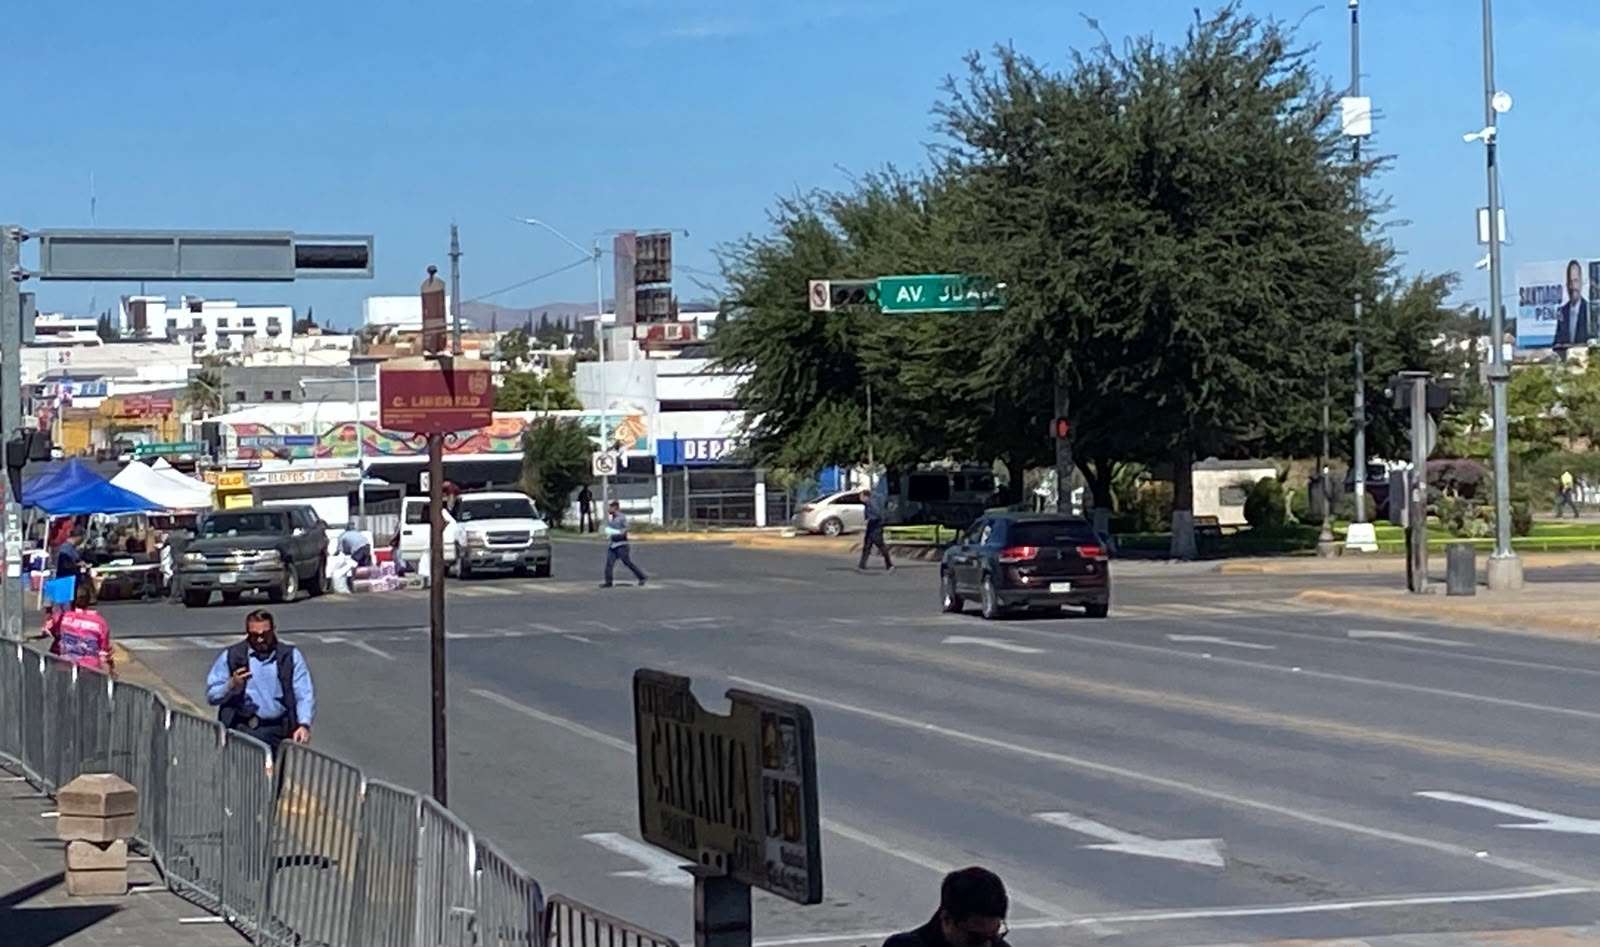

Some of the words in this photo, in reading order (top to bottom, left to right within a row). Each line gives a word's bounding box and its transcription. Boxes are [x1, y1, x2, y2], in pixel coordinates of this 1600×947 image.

[896, 285, 925, 303] AV.
[1519, 283, 1563, 307] SANTIAGO
[392, 396, 406, 407] C.
[411, 395, 481, 407] LIBERTAD
